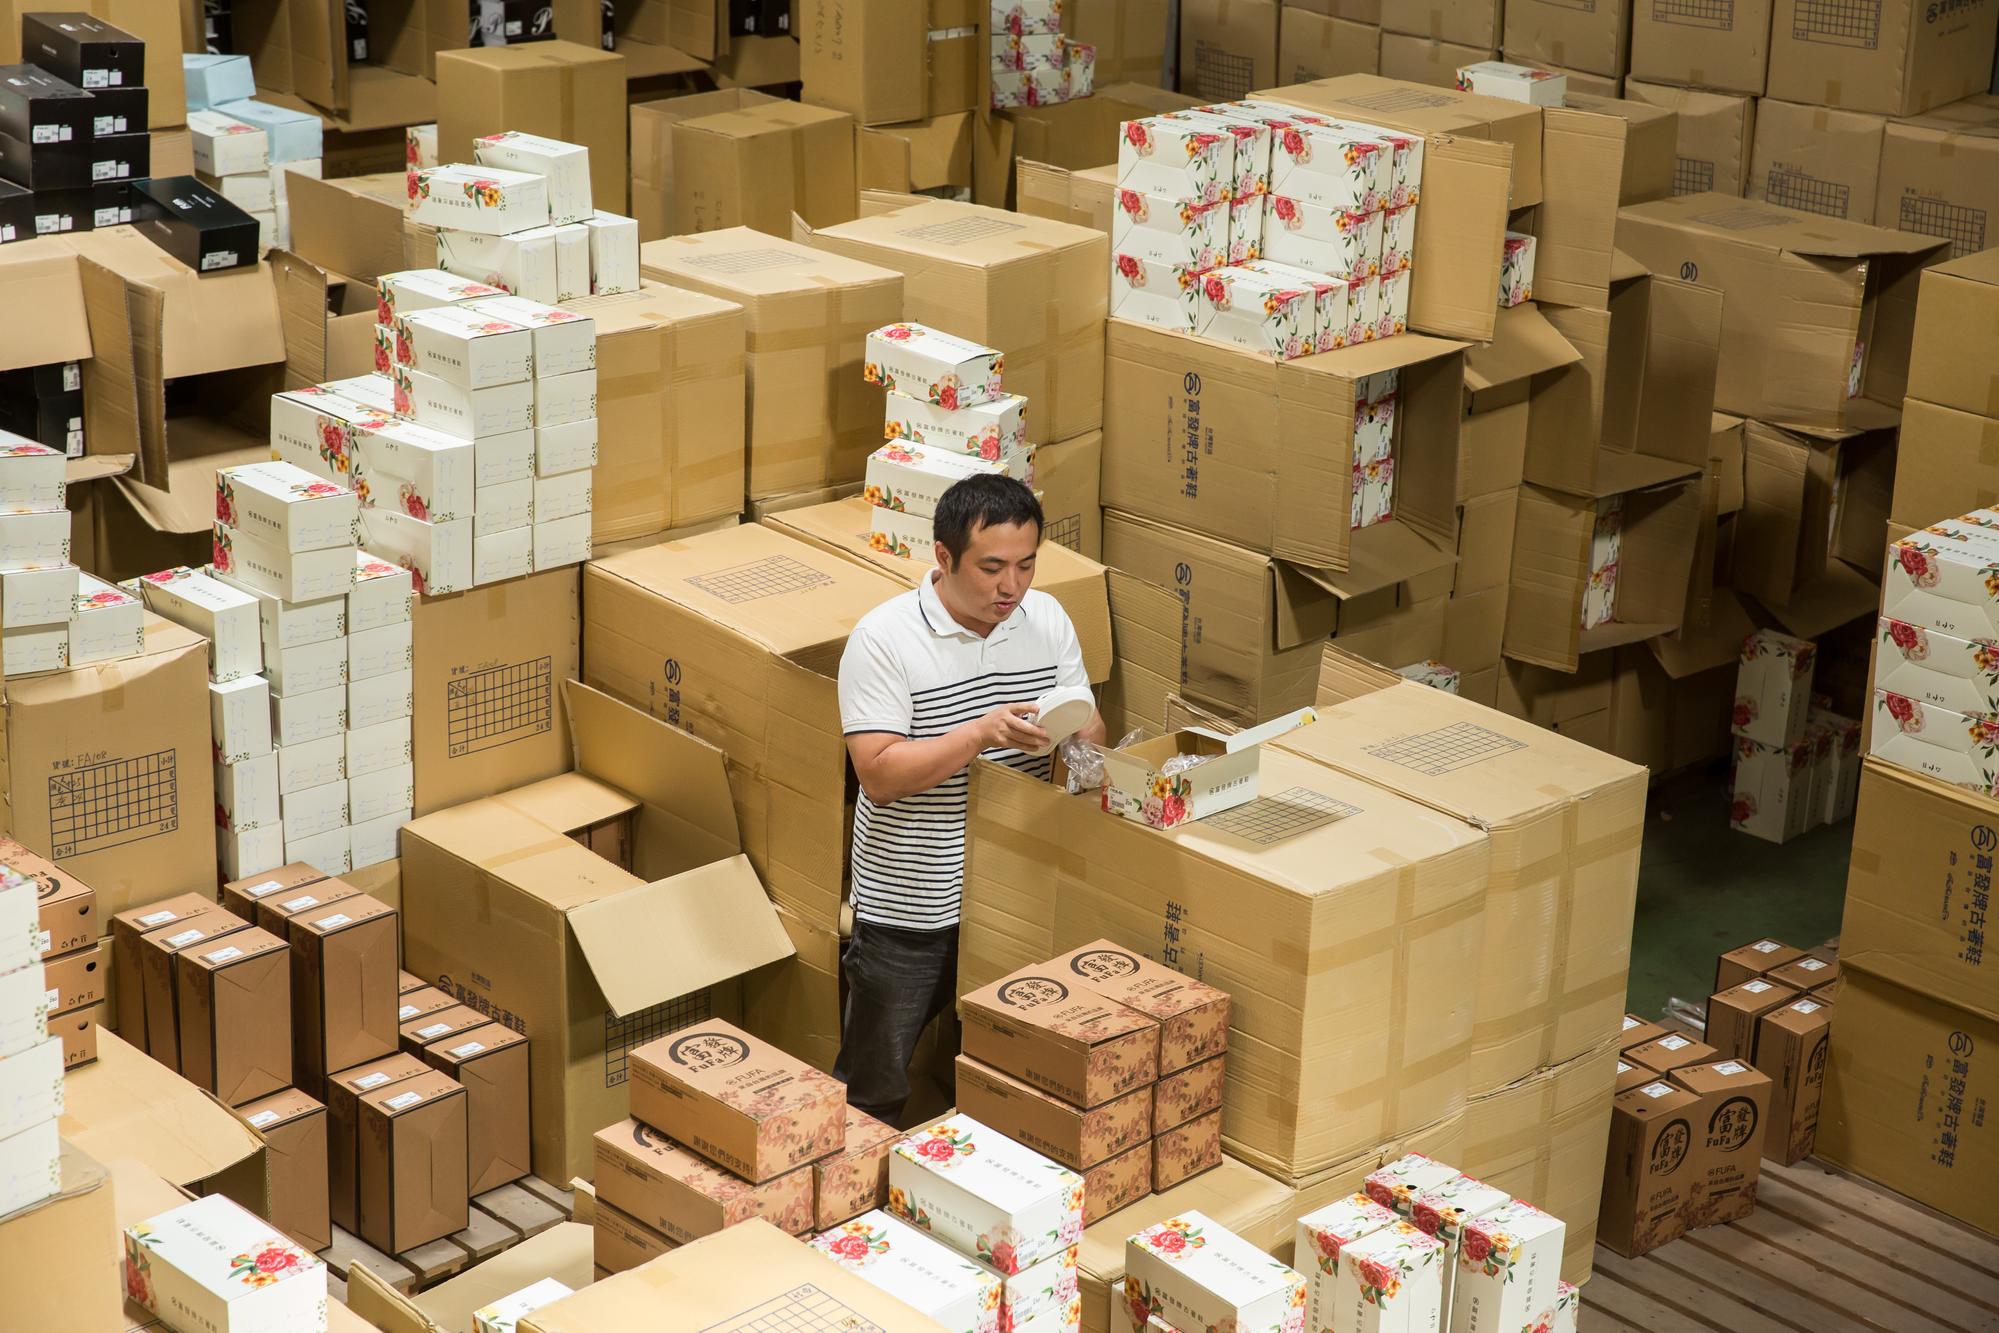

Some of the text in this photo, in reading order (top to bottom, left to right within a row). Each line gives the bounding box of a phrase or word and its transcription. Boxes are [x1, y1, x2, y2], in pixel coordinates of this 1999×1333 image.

[680, 1037, 740, 1064] 富發牌
[688, 1057, 725, 1074] FuFa
[735, 1068, 766, 1084] FUFA
[1719, 1107, 1751, 1142] 富發牌
[1659, 1129, 1685, 1160] 富發牌
[1706, 1135, 1730, 1148] FuFa
[1650, 1160, 1669, 1175] FuFa
